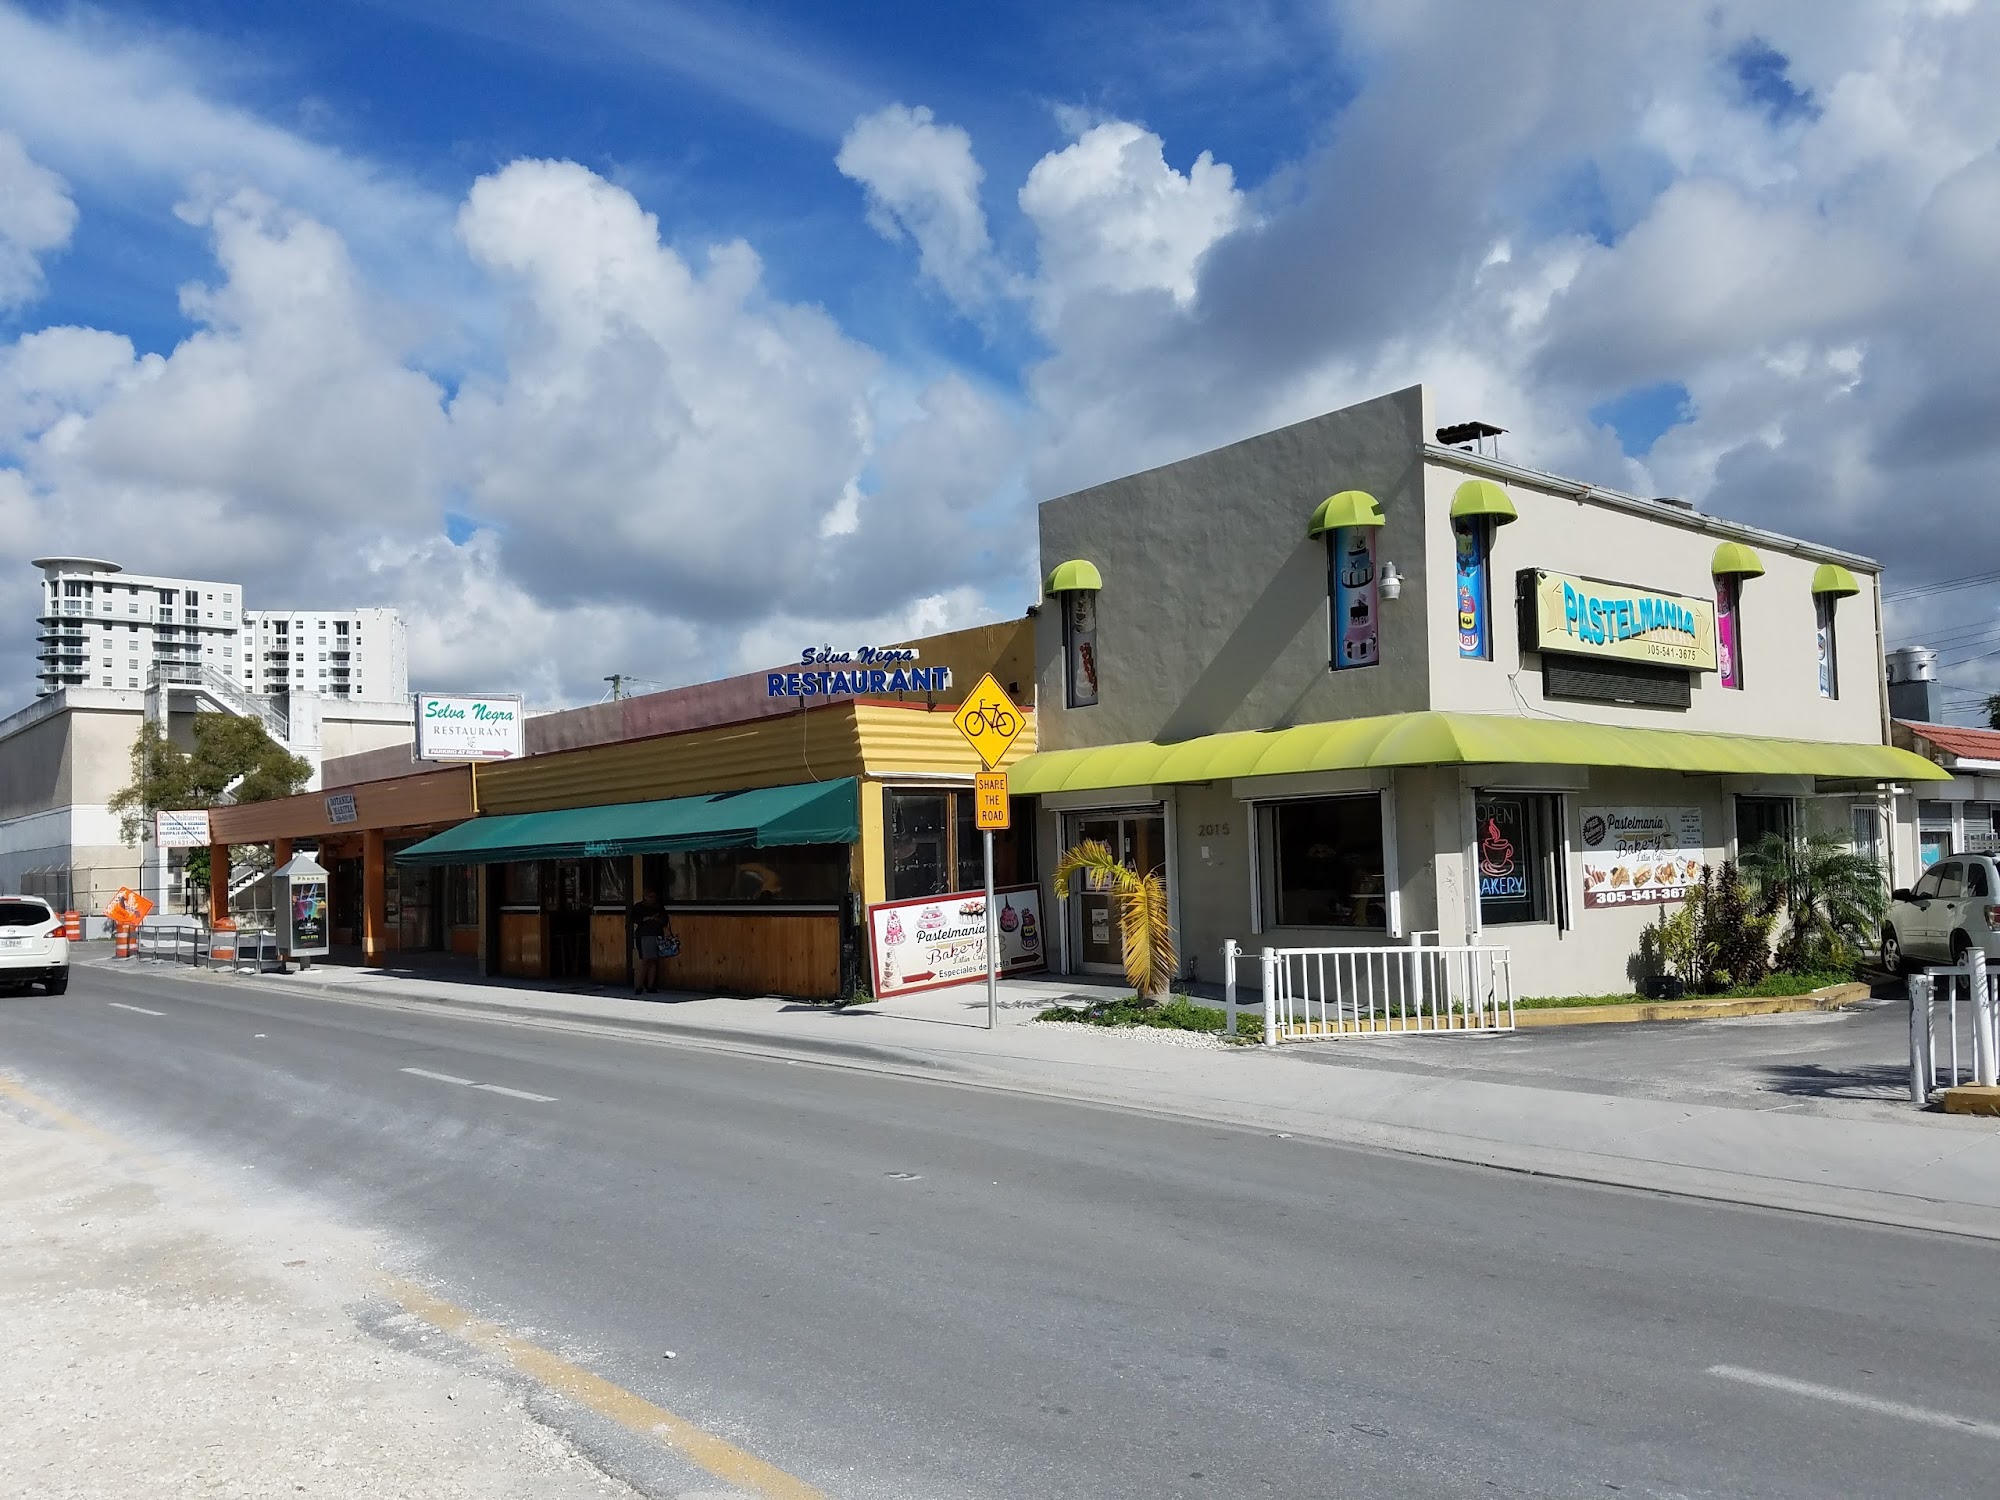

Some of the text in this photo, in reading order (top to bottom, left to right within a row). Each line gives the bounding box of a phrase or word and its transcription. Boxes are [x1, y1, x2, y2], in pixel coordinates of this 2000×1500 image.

[1563, 580, 1696, 646] PASTELMANIA
[801, 646, 914, 670] Selva Negra
[767, 666, 949, 697] RESTAURANT
[425, 701, 515, 726] Selva Negra
[433, 725, 509, 737] RESTAURANT
[978, 779, 1005, 790] SHARE
[984, 794, 1000, 806] THE
[982, 810, 1004, 822] ROAD
[1477, 804, 1514, 824] OPEN
[1607, 813, 1664, 830] Pastelmanía
[1198, 821, 1231, 837] 2015
[1615, 834, 1661, 859] Bakery
[1480, 876, 1523, 895] AKERY
[1596, 887, 1687, 904] 305-541-367
[916, 923, 987, 944] Pastelmanía
[926, 936, 988, 966] Bakery
[938, 959, 1010, 978] Especiales de esta
